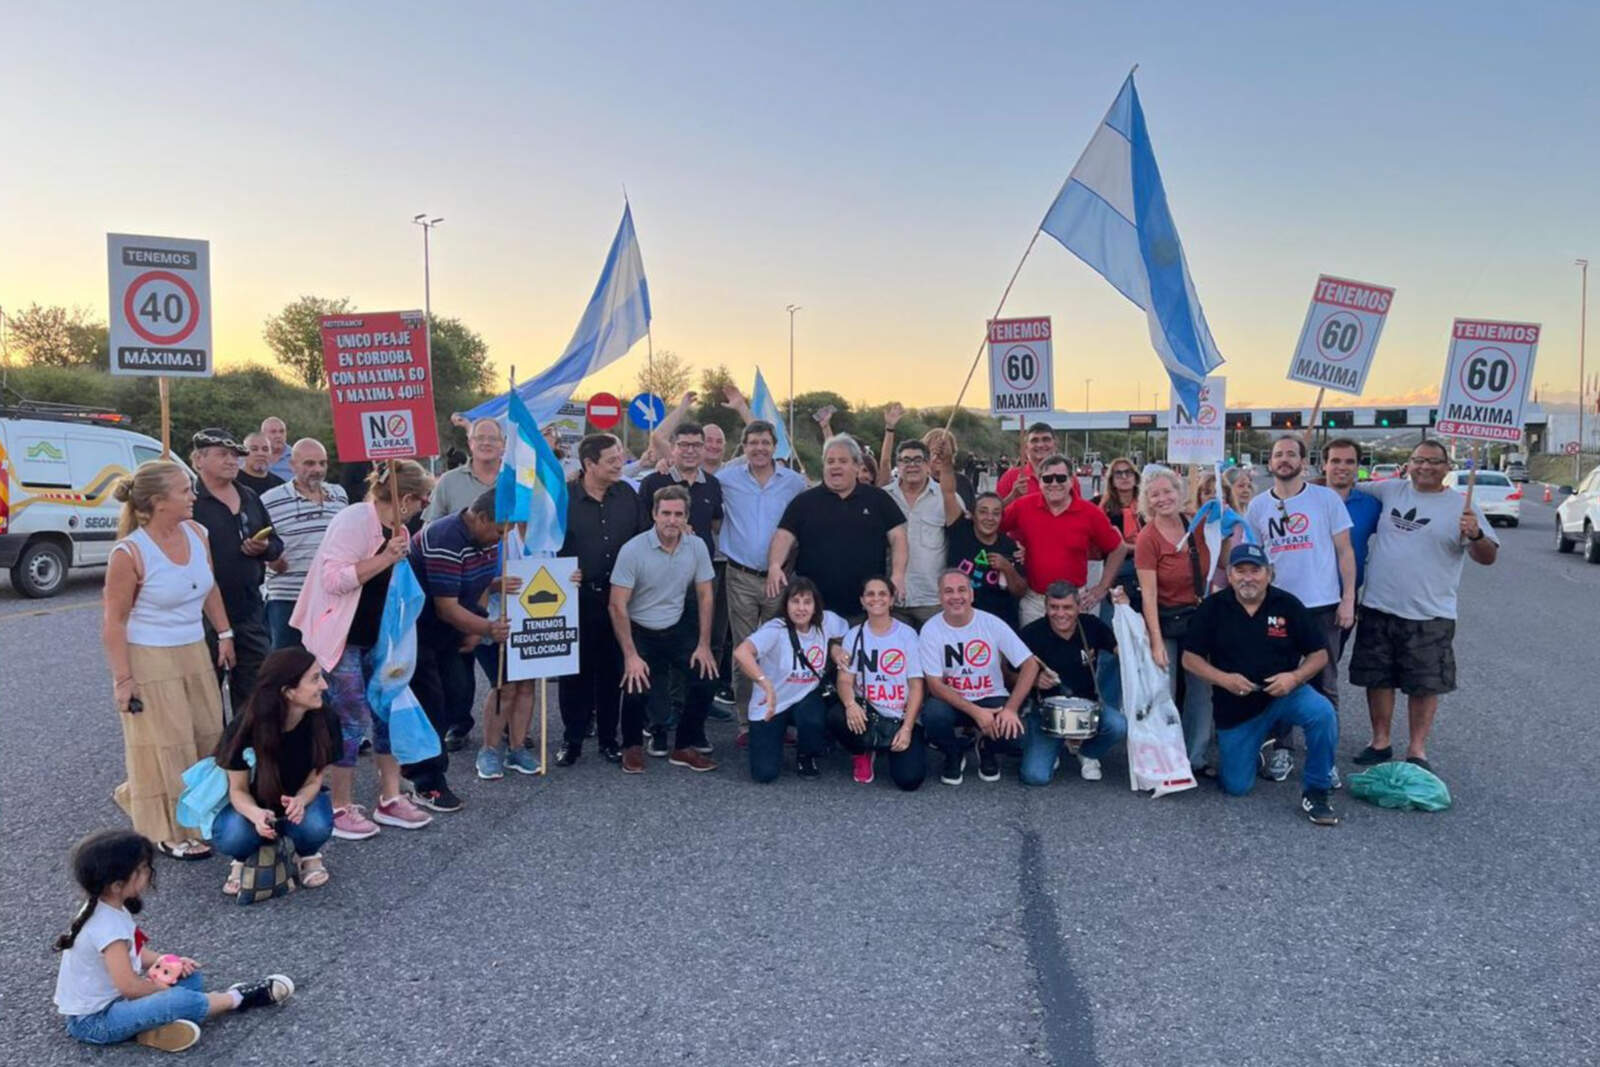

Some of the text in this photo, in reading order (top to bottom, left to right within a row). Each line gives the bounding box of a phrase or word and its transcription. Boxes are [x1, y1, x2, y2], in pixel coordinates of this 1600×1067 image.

[127, 250, 191, 265] TENEMOS
[1318, 281, 1390, 311] TENEMOS
[140, 292, 183, 324] 40
[336, 331, 411, 348] UNICO PEAJE
[989, 321, 1049, 340] TENEMOS
[1322, 319, 1358, 353] 60
[1455, 323, 1537, 342] TENEMOS
[339, 350, 413, 367] EN CORDOBA
[1007, 354, 1034, 381] 60
[332, 367, 425, 385] CON MAXIMA 60
[1296, 358, 1358, 388] MAXIMA
[1467, 357, 1509, 392] 60
[336, 389, 343, 403] Y
[346, 387, 394, 402] MAXIMA
[996, 392, 1047, 409] MAXIMA
[1448, 403, 1513, 425] MAXIMA
[1439, 422, 1518, 440] ES AVENIDA!!
[372, 438, 409, 448] AL PEAJE
[526, 618, 563, 630] TENEMOS
[513, 630, 576, 645] REDUCTORES DE
[522, 644, 567, 656] VELOCIDAD
